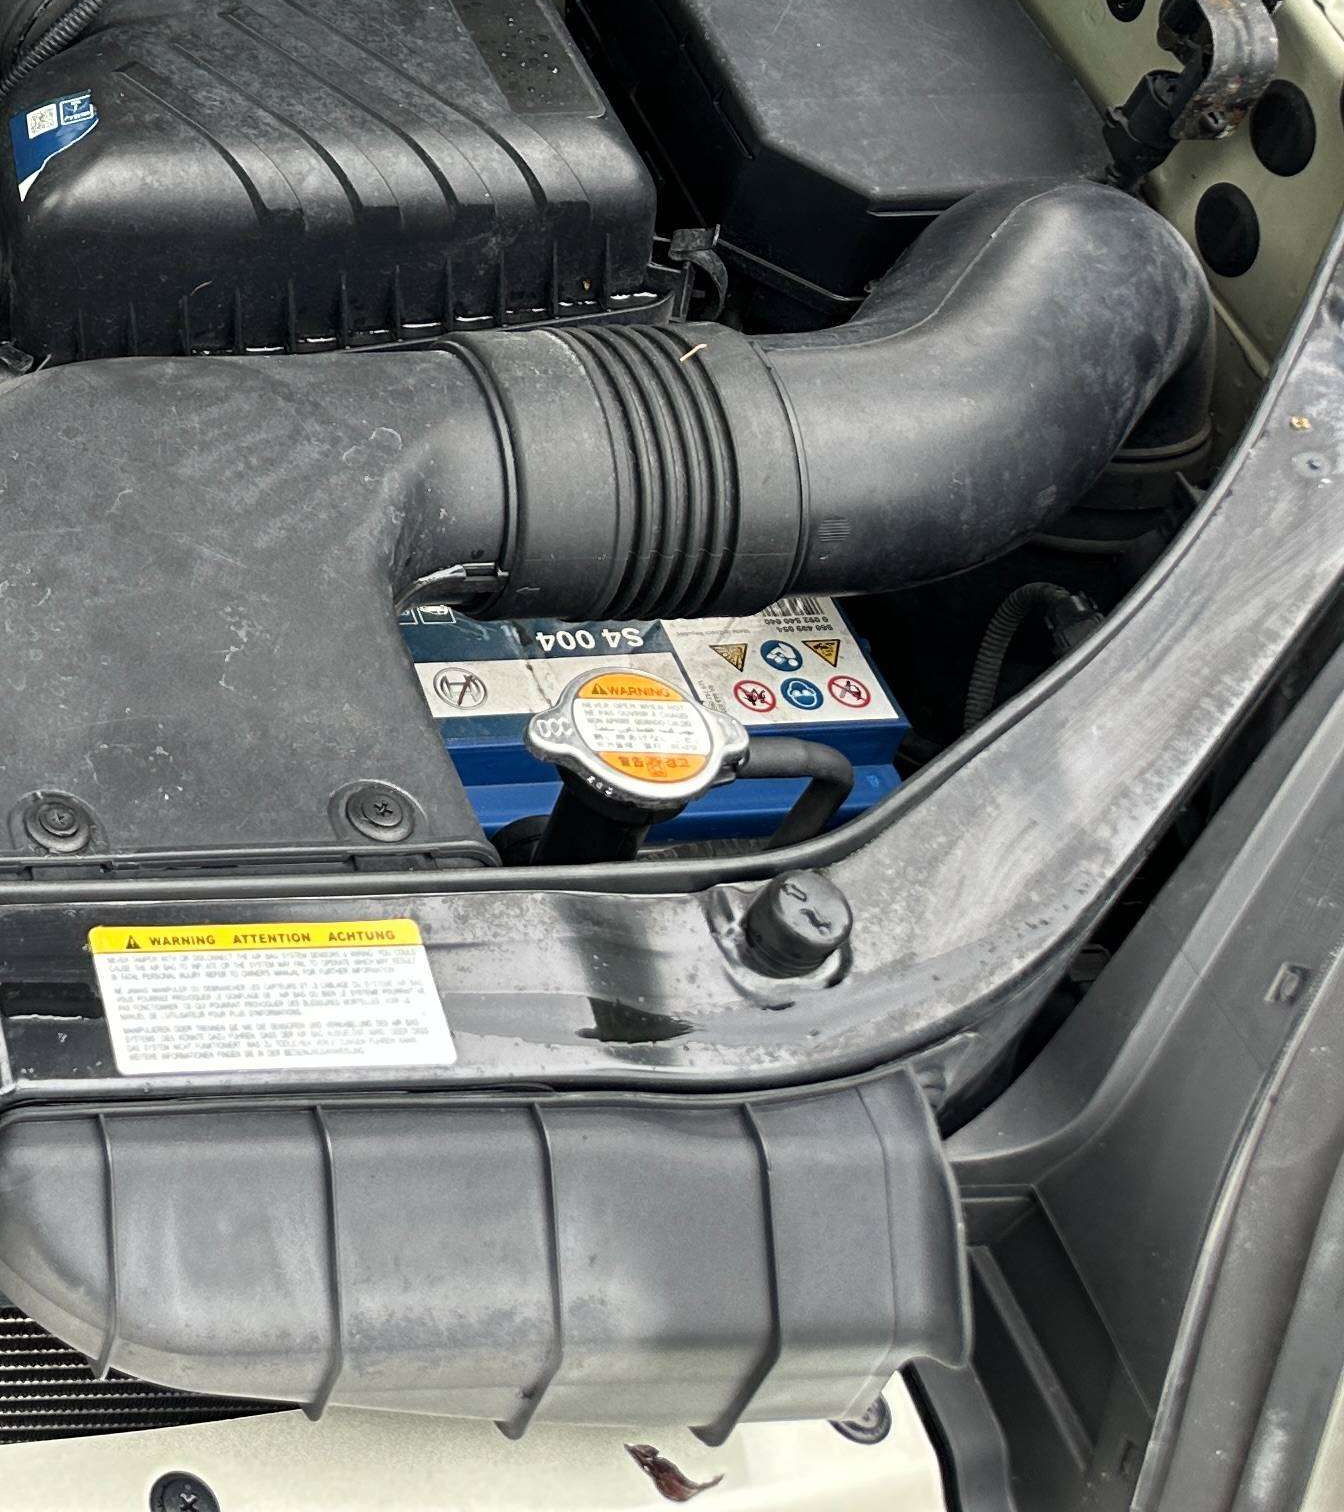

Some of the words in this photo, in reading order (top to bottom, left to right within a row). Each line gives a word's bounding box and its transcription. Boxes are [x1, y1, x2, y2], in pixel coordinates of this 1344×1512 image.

[535, 629, 596, 652] 004
[601, 627, 644, 648] S4
[607, 685, 671, 698] WARNING
[149, 934, 216, 946] WARNING
[232, 932, 311, 945] ATTENTION
[328, 930, 396, 943] ACHTUNG
